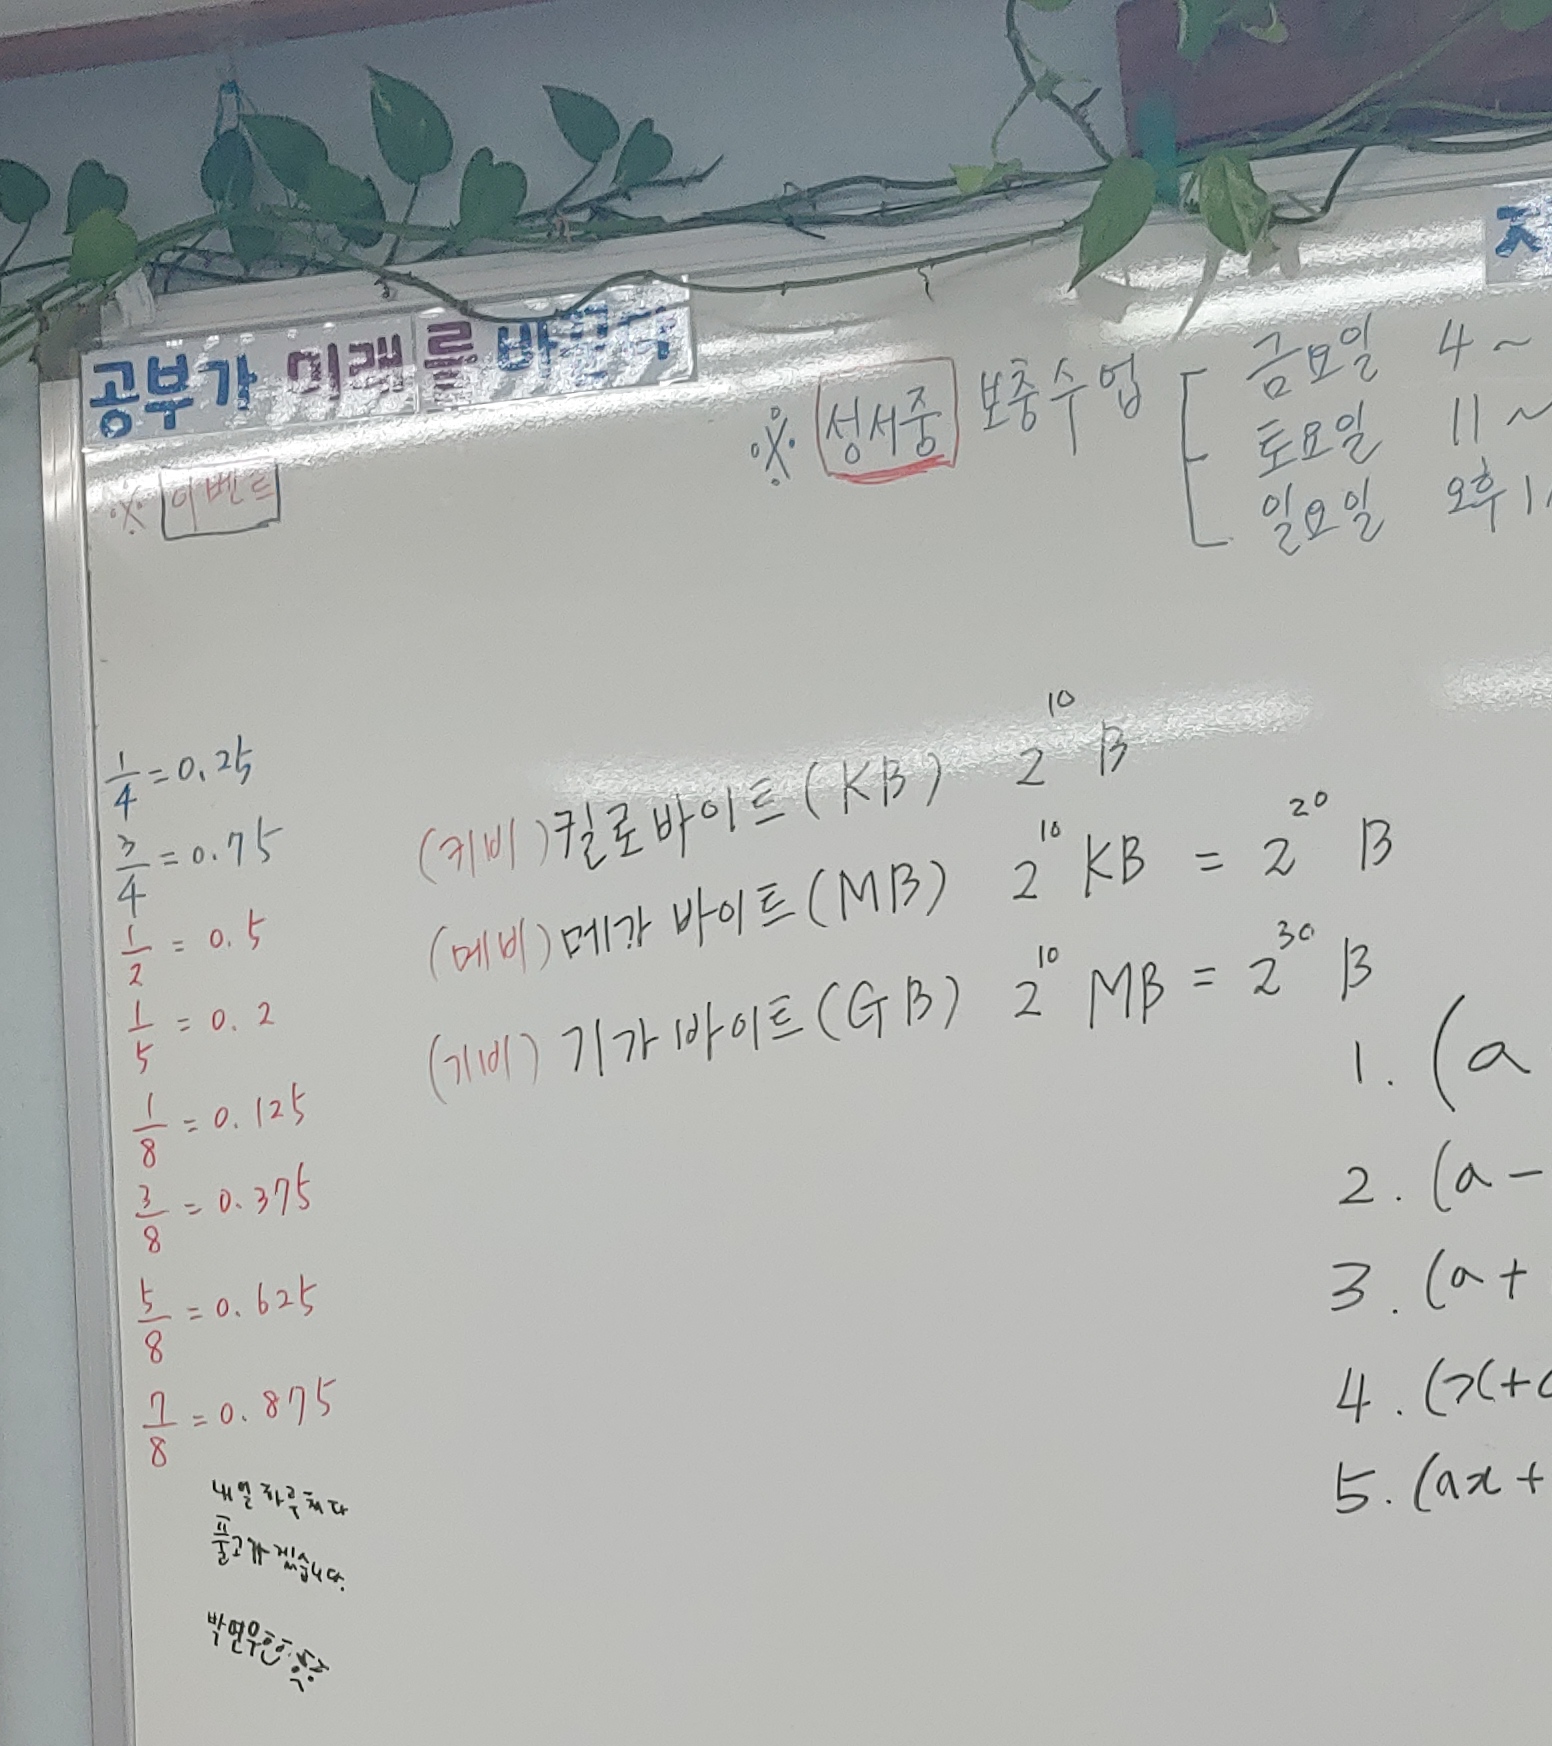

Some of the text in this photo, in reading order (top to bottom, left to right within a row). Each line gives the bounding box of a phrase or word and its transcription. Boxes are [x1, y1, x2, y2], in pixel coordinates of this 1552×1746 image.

[89, 353, 258, 438] 공부가
[287, 320, 475, 410] 미래를
[1247, 321, 1376, 407] 금요일
[824, 355, 1142, 465] 성서중 보충수업
[1257, 400, 1382, 476] 토요일
[1262, 480, 1384, 553] 일요일
